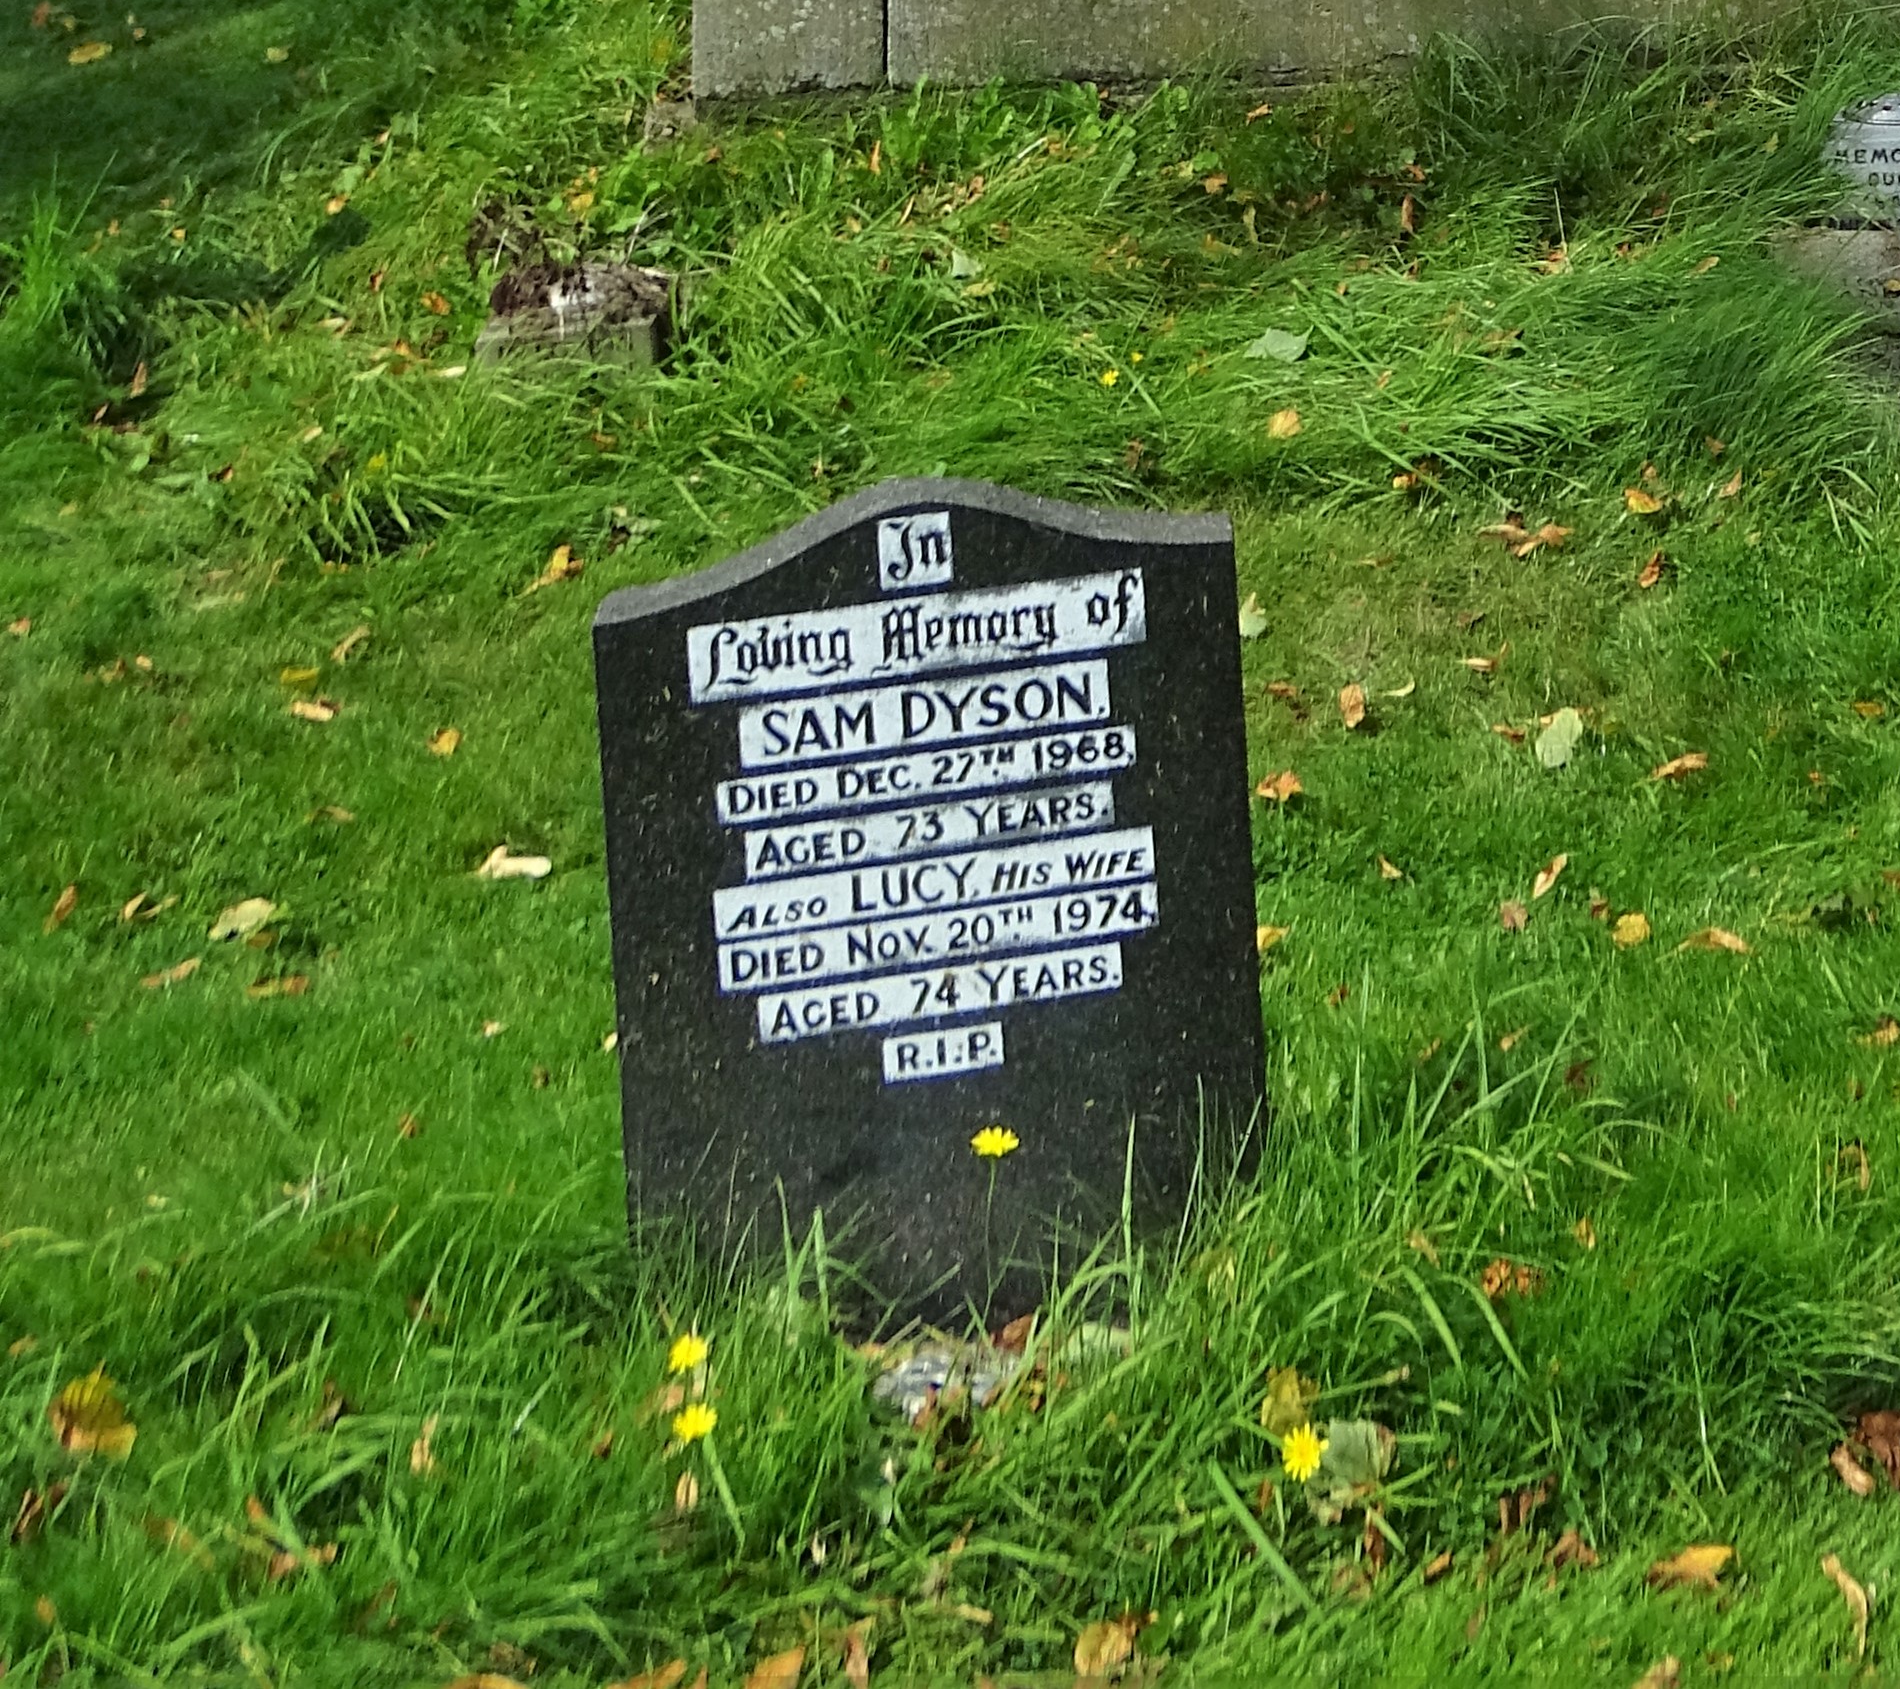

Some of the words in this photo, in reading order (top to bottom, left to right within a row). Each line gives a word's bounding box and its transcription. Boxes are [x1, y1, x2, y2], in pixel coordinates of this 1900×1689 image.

[887, 521, 946, 582] In
[703, 621, 853, 692] Loving
[871, 603, 1058, 676] Memory
[1087, 574, 1138, 634] of
[761, 699, 876, 757] SAM
[901, 673, 1106, 740] DYSON.
[728, 778, 819, 816] DIED
[836, 763, 921, 800] DEC.
[755, 827, 866, 870] AGED
[896, 810, 945, 849] 73
[964, 793, 1109, 837] YEARS.
[726, 896, 828, 933] ALSO
[991, 860, 1053, 893] HIS
[1065, 847, 1147, 883] WIFE
[730, 942, 825, 983] DIED
[847, 924, 933, 966] NOV.
[771, 991, 880, 1035] AGED
[910, 974, 960, 1015] 74
[975, 956, 1120, 1002] YEARS.
[897, 1031, 997, 1071] R.I.P.
